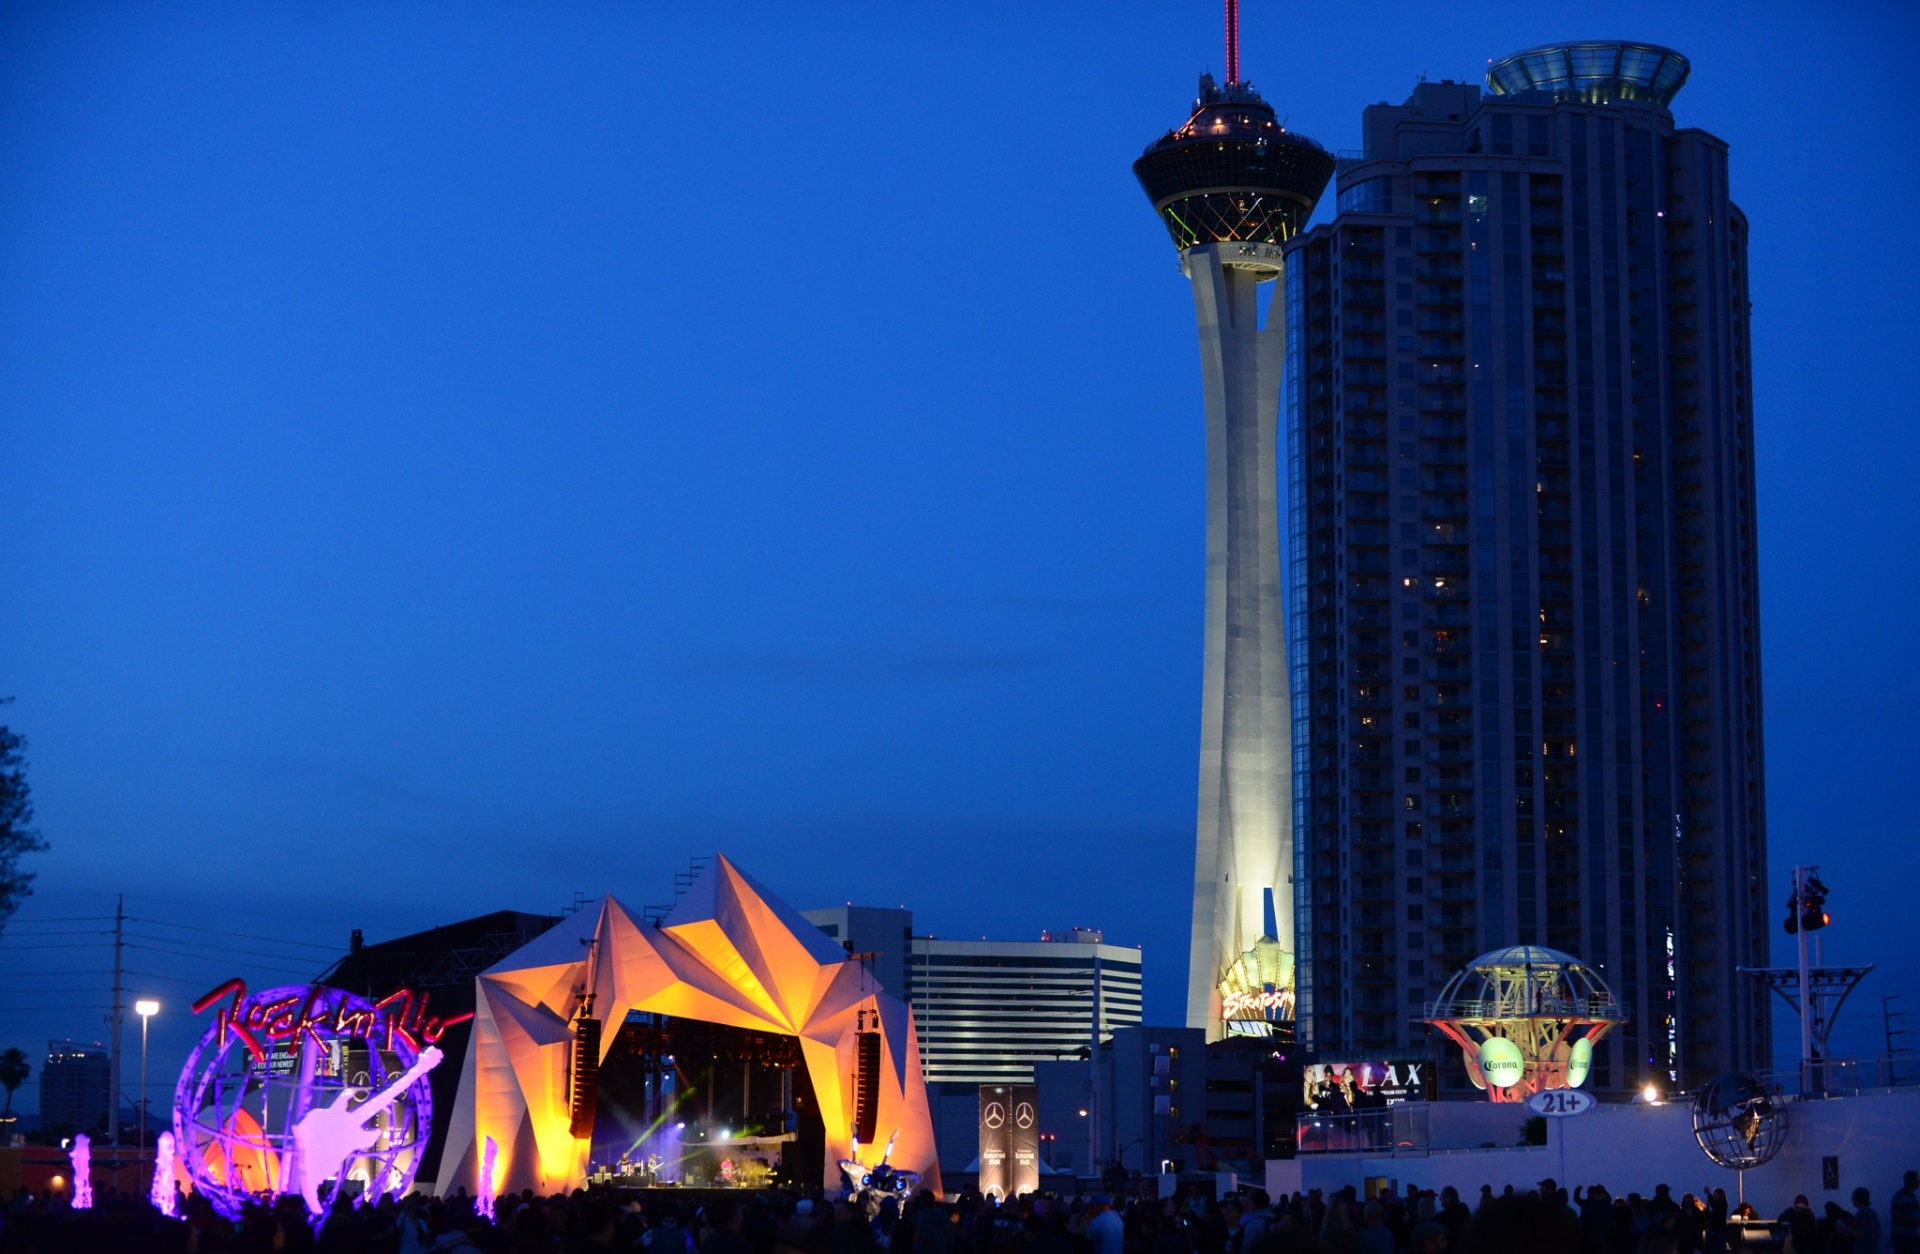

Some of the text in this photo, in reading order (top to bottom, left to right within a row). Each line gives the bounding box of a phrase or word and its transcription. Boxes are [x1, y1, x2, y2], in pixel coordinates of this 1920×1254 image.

[191, 977, 329, 1062] Rock
[375, 989, 475, 1054] Rio
[1361, 1063, 1422, 1087] LAX
[1484, 1060, 1518, 1073] Corona
[1570, 1059, 1588, 1071] Corona
[1542, 1093, 1581, 1113] 21+
